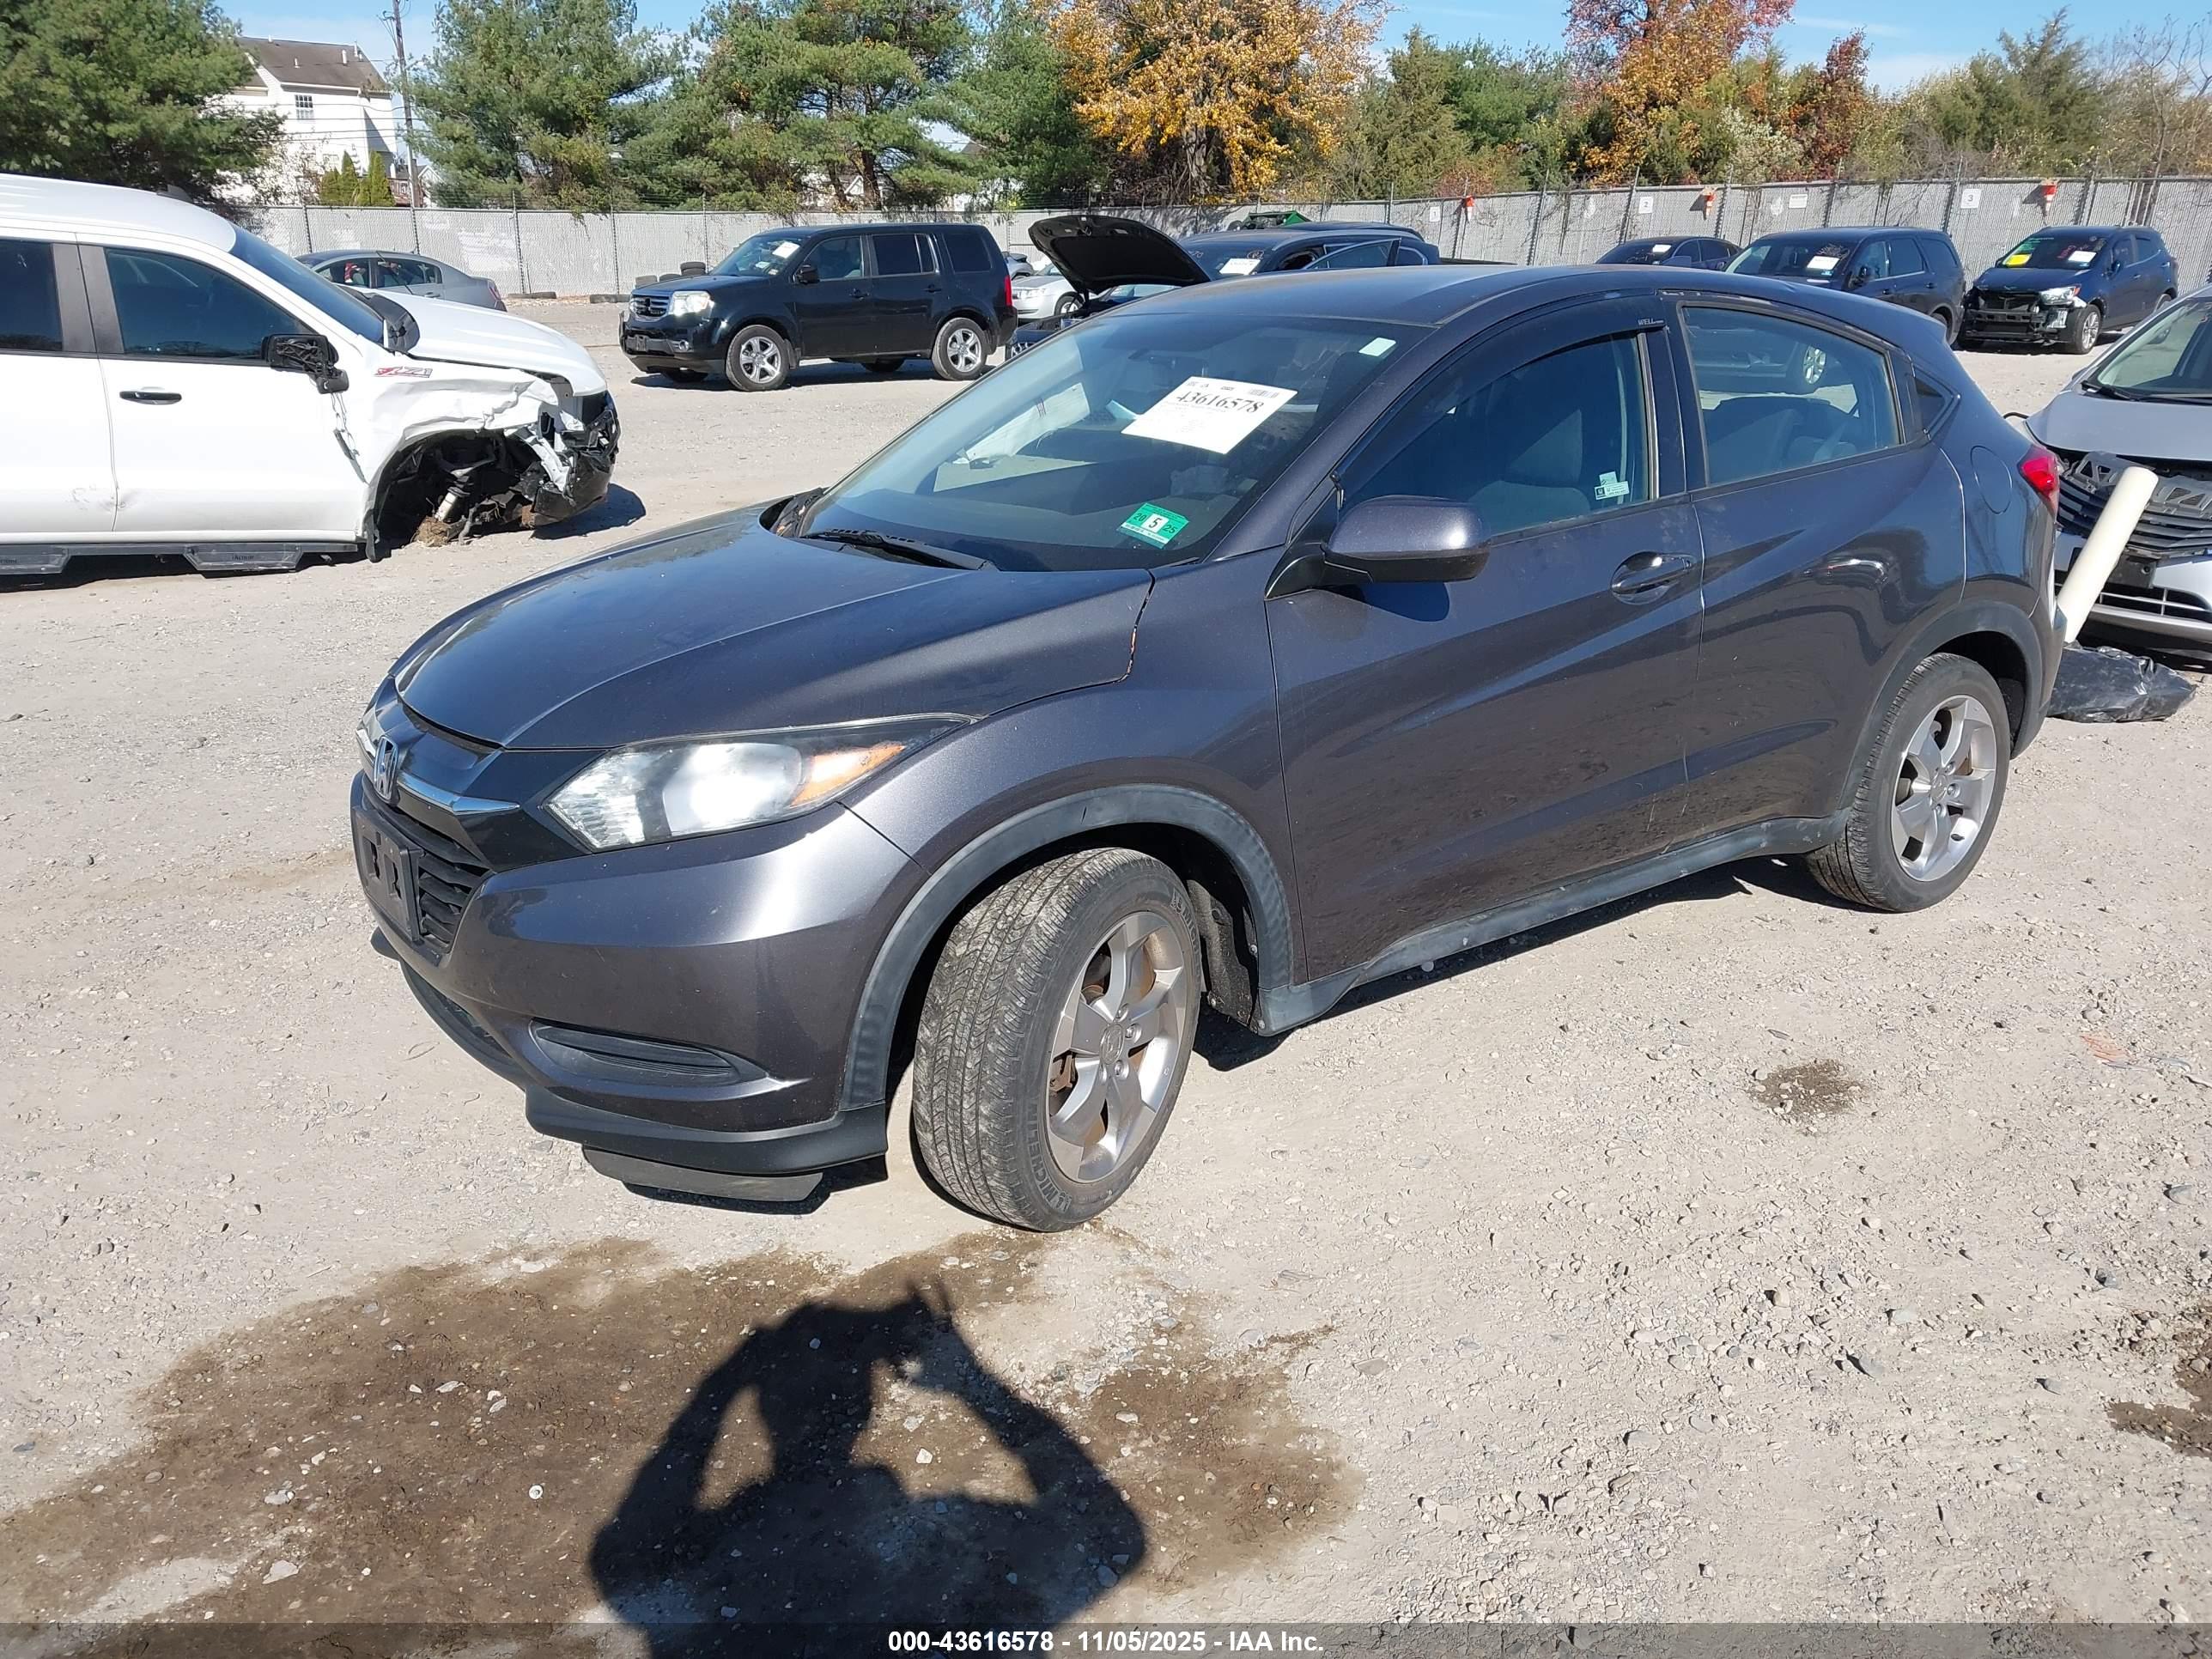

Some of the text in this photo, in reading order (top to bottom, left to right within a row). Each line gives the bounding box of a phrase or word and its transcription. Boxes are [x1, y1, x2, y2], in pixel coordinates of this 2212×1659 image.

[1176, 391, 1264, 413] 43616578
[1133, 513, 1147, 522] 20
[1148, 517, 1163, 529] 5
[1163, 524, 1177, 534] 25
[1028, 1099, 1059, 1202] MICHELIN
